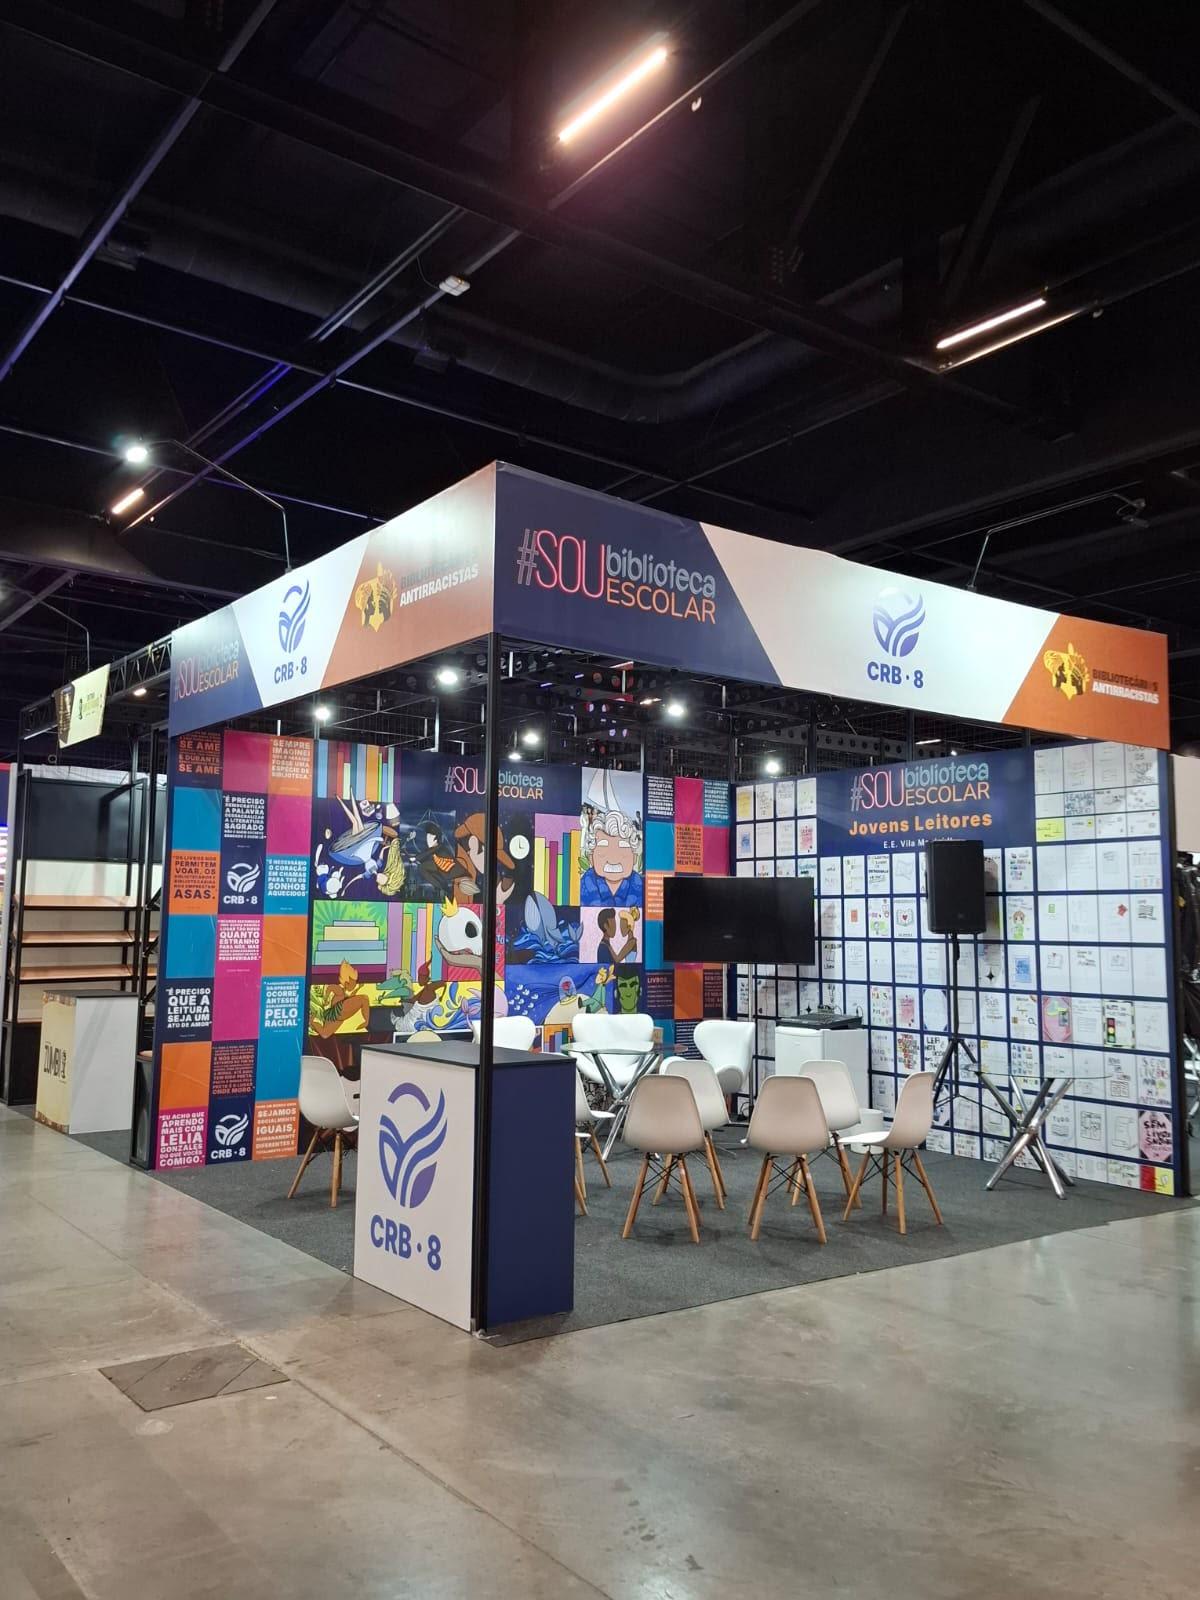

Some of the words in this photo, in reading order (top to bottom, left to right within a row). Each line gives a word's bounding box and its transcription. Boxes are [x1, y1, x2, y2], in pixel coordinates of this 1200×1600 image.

[517, 529, 605, 598] #SOU
[606, 545, 716, 598] biblioteca
[400, 563, 480, 607] ANTIRRACISTAS
[607, 579, 716, 624] ESCOLAR
[198, 660, 239, 692] ESCOLAR
[274, 661, 294, 684] CRB
[867, 661, 902, 685] CRB
[180, 740, 193, 749] SE
[196, 742, 220, 752] AME
[179, 764, 192, 773] SE
[850, 768, 904, 812] #SOU
[904, 762, 989, 788] biblioteca
[905, 782, 990, 806] ESCOLAR
[231, 797, 265, 805] PRECISO
[224, 823, 264, 831] SAGRADO
[849, 821, 909, 835] Jovens
[914, 814, 992, 831] Leitores
[900, 839, 915, 847] Vila
[268, 882, 306, 891] SONHOS
[174, 889, 215, 899] ASAS.
[223, 896, 245, 904] CRB
[220, 931, 260, 939] QUANTO
[175, 988, 211, 996] PRECISO
[168, 995, 197, 1006] QUE
[200, 995, 210, 1005] A
[168, 1006, 210, 1014] LEITURA
[265, 1008, 298, 1019] PELO
[168, 1014, 192, 1022] SEJA
[194, 1014, 210, 1022] UM
[258, 1108, 296, 1117] SEJAMOS
[162, 1118, 205, 1128] APRENDO
[161, 1127, 183, 1135] MAIS
[257, 1124, 295, 1135] IGUAIS,
[161, 1132, 203, 1147] LELIA
[160, 1144, 203, 1153] GONZALES
[211, 1149, 232, 1159] CRB
[371, 1214, 412, 1260] CRB
